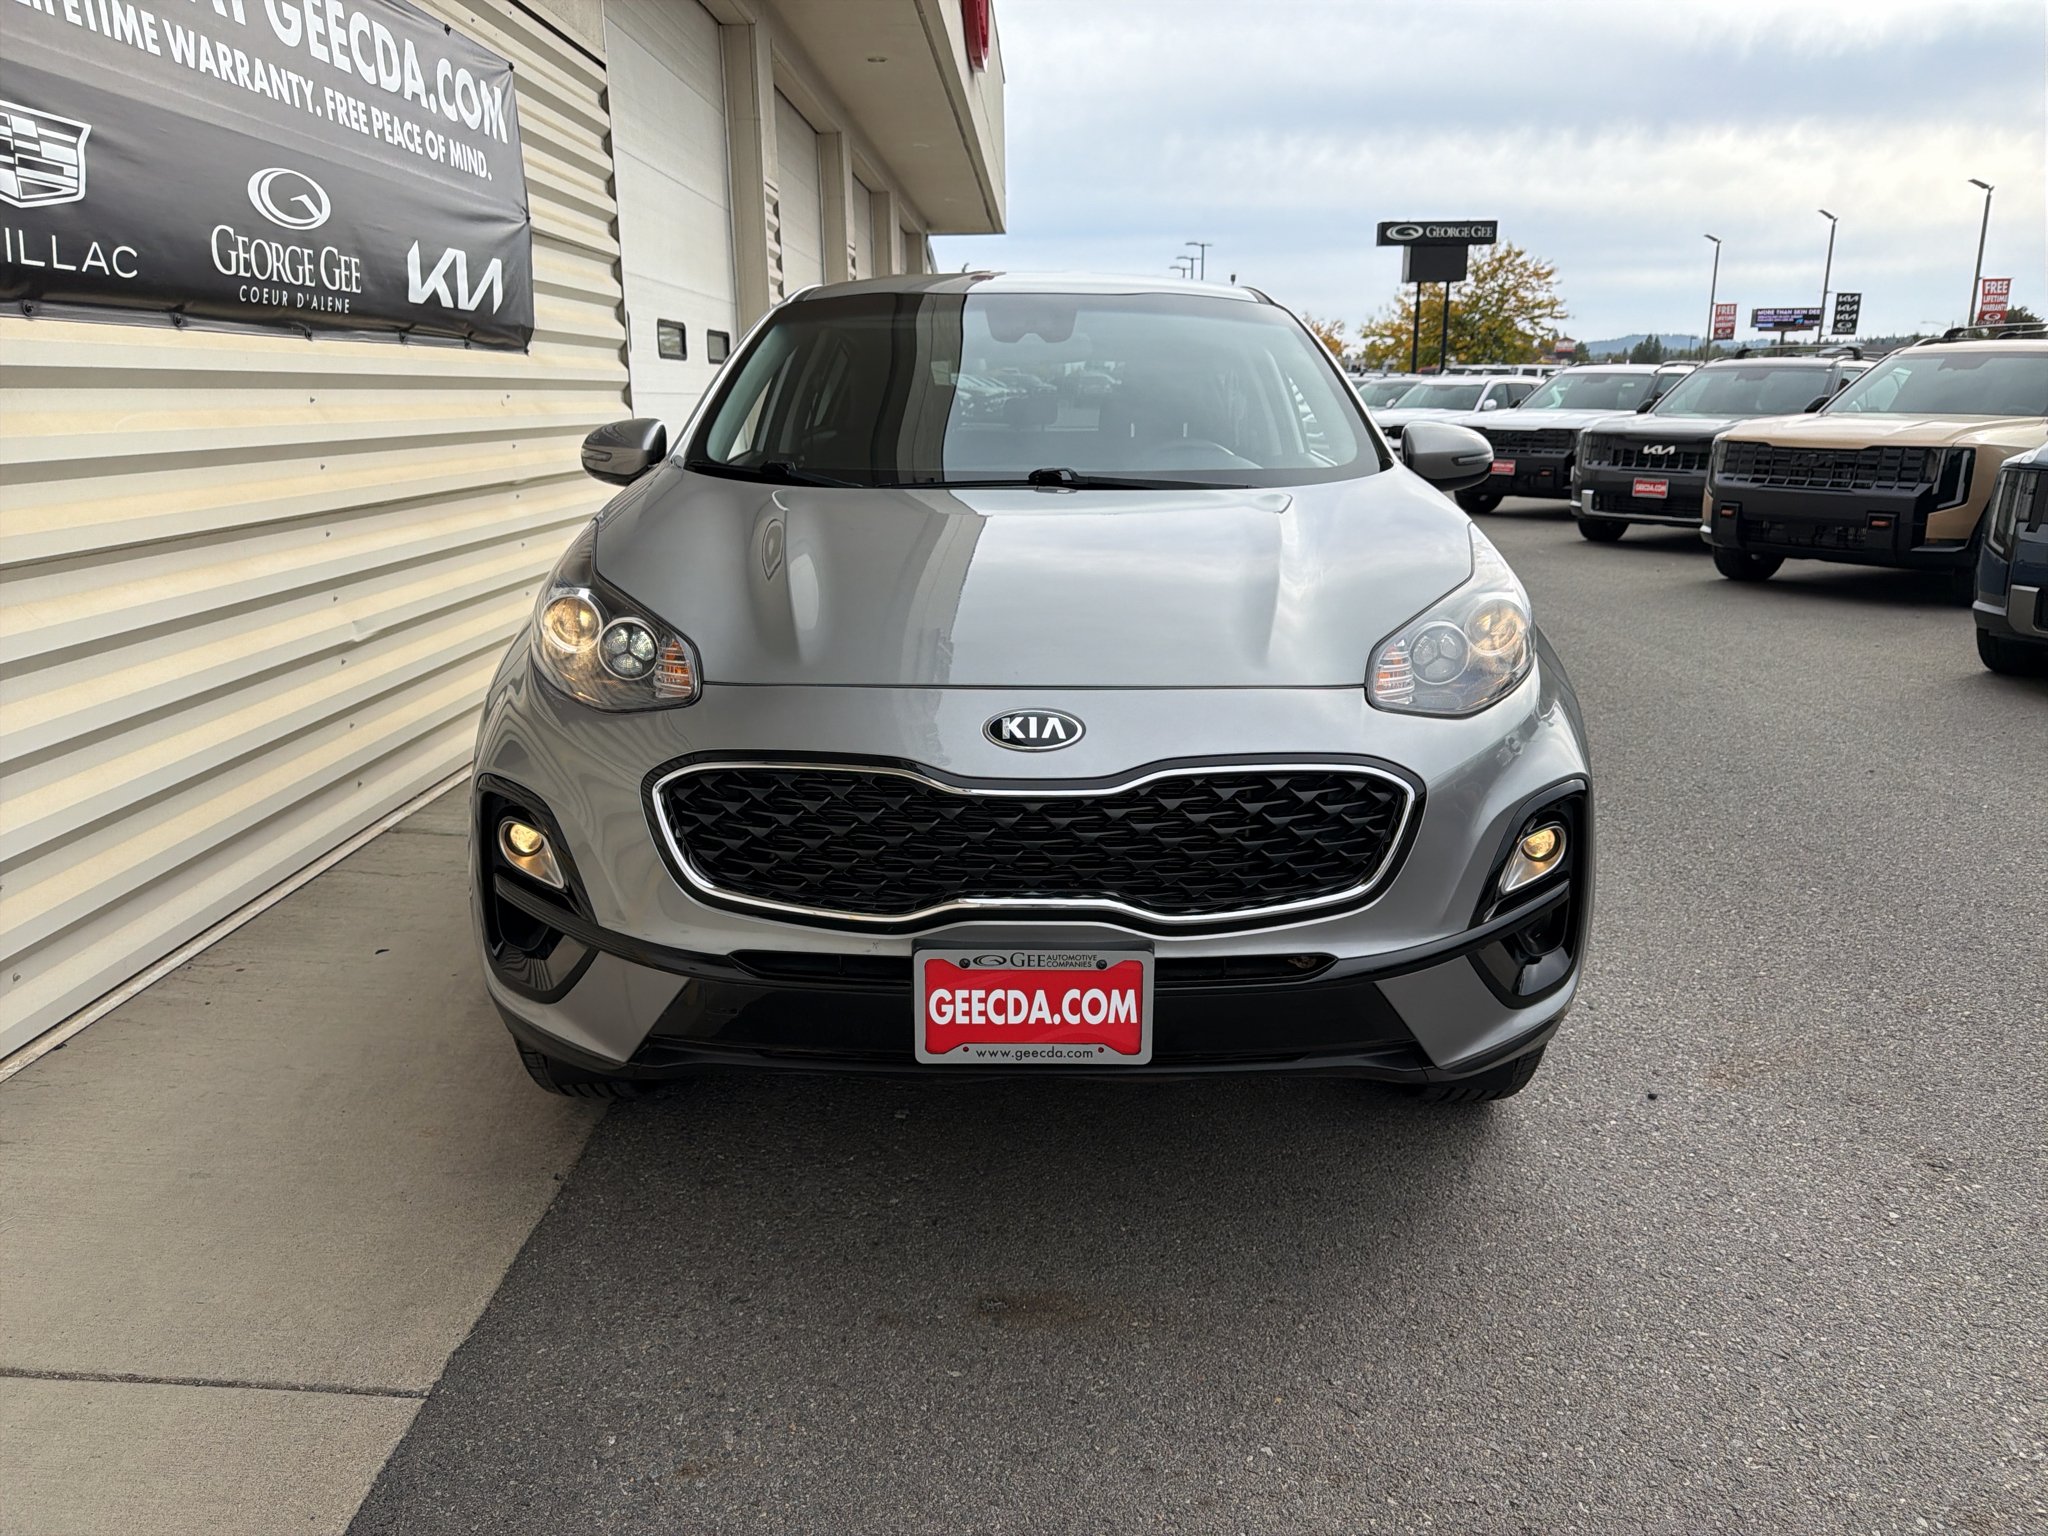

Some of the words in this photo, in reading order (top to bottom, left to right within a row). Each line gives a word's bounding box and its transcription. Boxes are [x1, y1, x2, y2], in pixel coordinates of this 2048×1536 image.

[264, 0, 508, 145] GEECDA.COM
[15, 0, 161, 56] ETIME
[162, 19, 322, 117] WARRANTY.
[324, 87, 370, 135] FREE
[370, 106, 424, 155] PEACE
[425, 129, 446, 163] OF
[448, 139, 492, 181] MIND.
[1425, 225, 1470, 238] GEORGE
[1470, 225, 1493, 238] GEE
[211, 225, 316, 287] GEORGE
[320, 246, 362, 293] GEE
[239, 285, 288, 307] COEUR
[296, 293, 350, 314] D'ALENE
[1984, 281, 2009, 294] FREE
[1717, 305, 1735, 315] FREE
[1002, 716, 1067, 740] KIA
[1010, 952, 1047, 968] GEE
[929, 988, 1138, 1025] GEECDA.COM
[976, 1046, 1094, 1061] www.geecda.com
